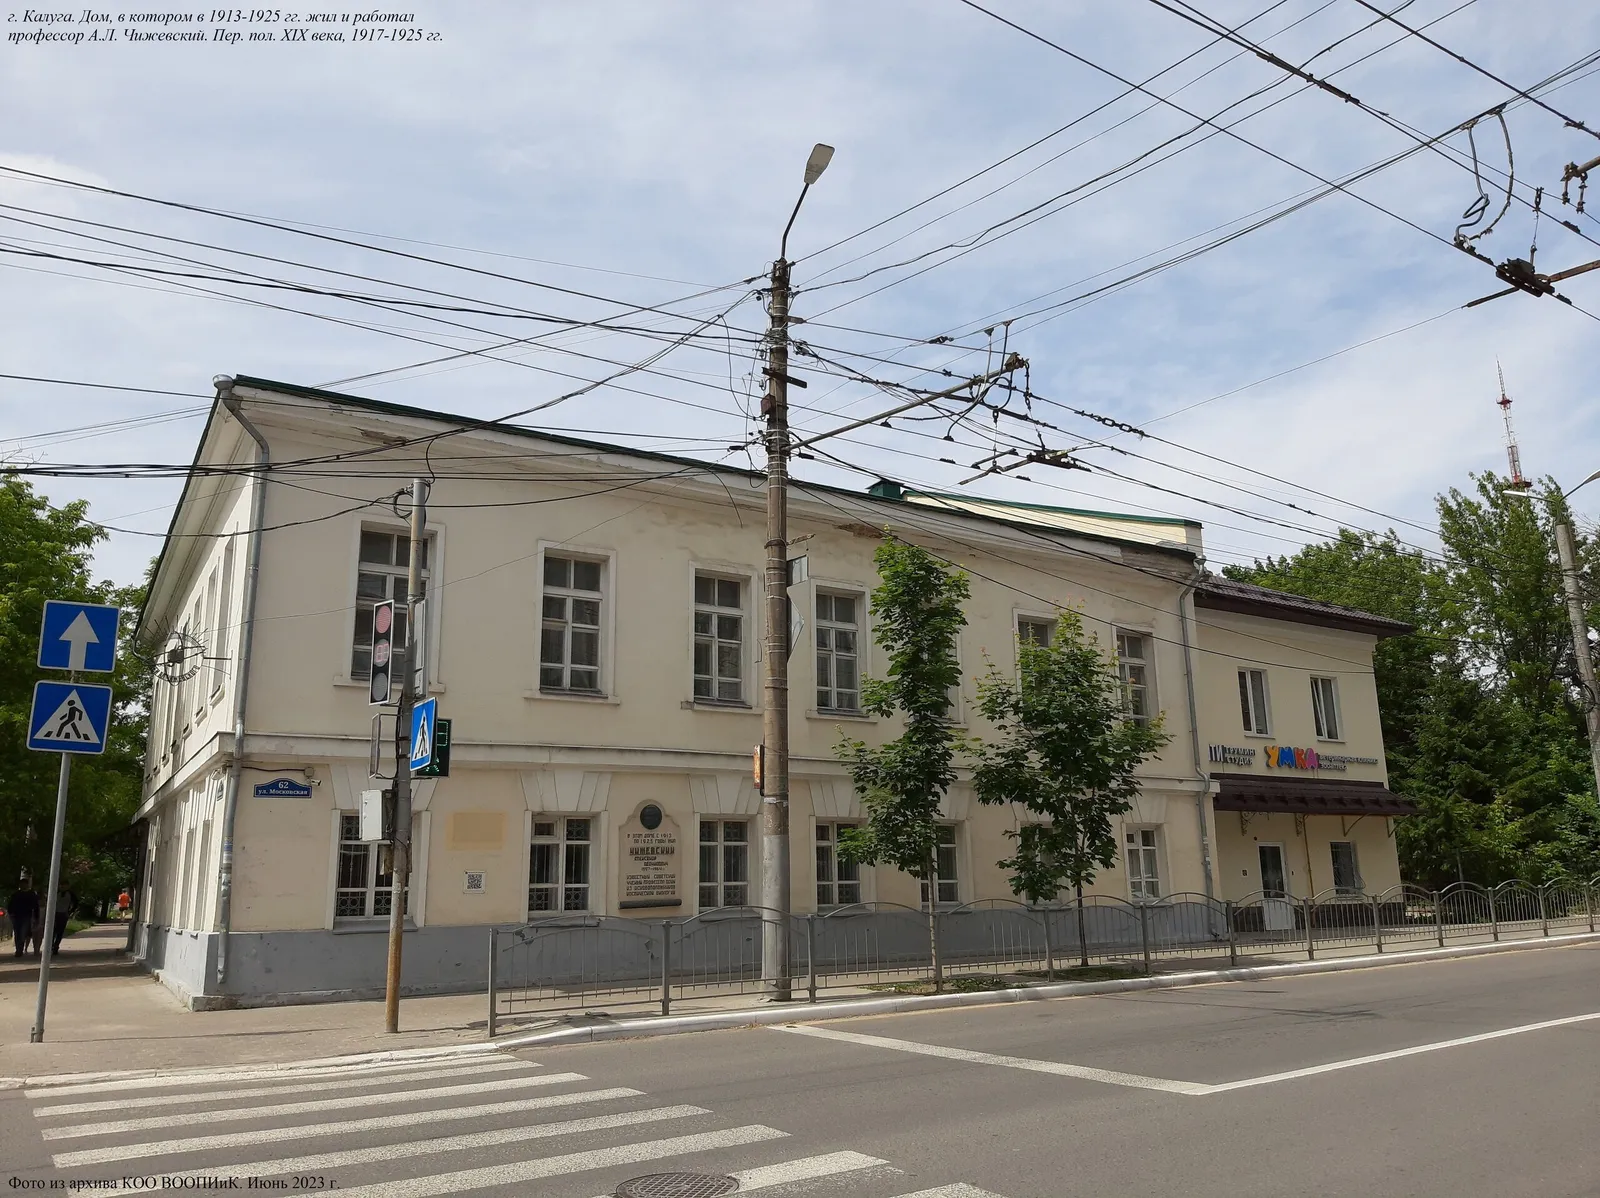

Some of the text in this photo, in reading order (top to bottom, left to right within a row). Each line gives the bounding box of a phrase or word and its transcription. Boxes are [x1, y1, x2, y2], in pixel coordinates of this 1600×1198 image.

[1225, 756, 1254, 765] СТУДИЯ
[1264, 745, 1318, 769] УМКА
[278, 781, 289, 789] 62
